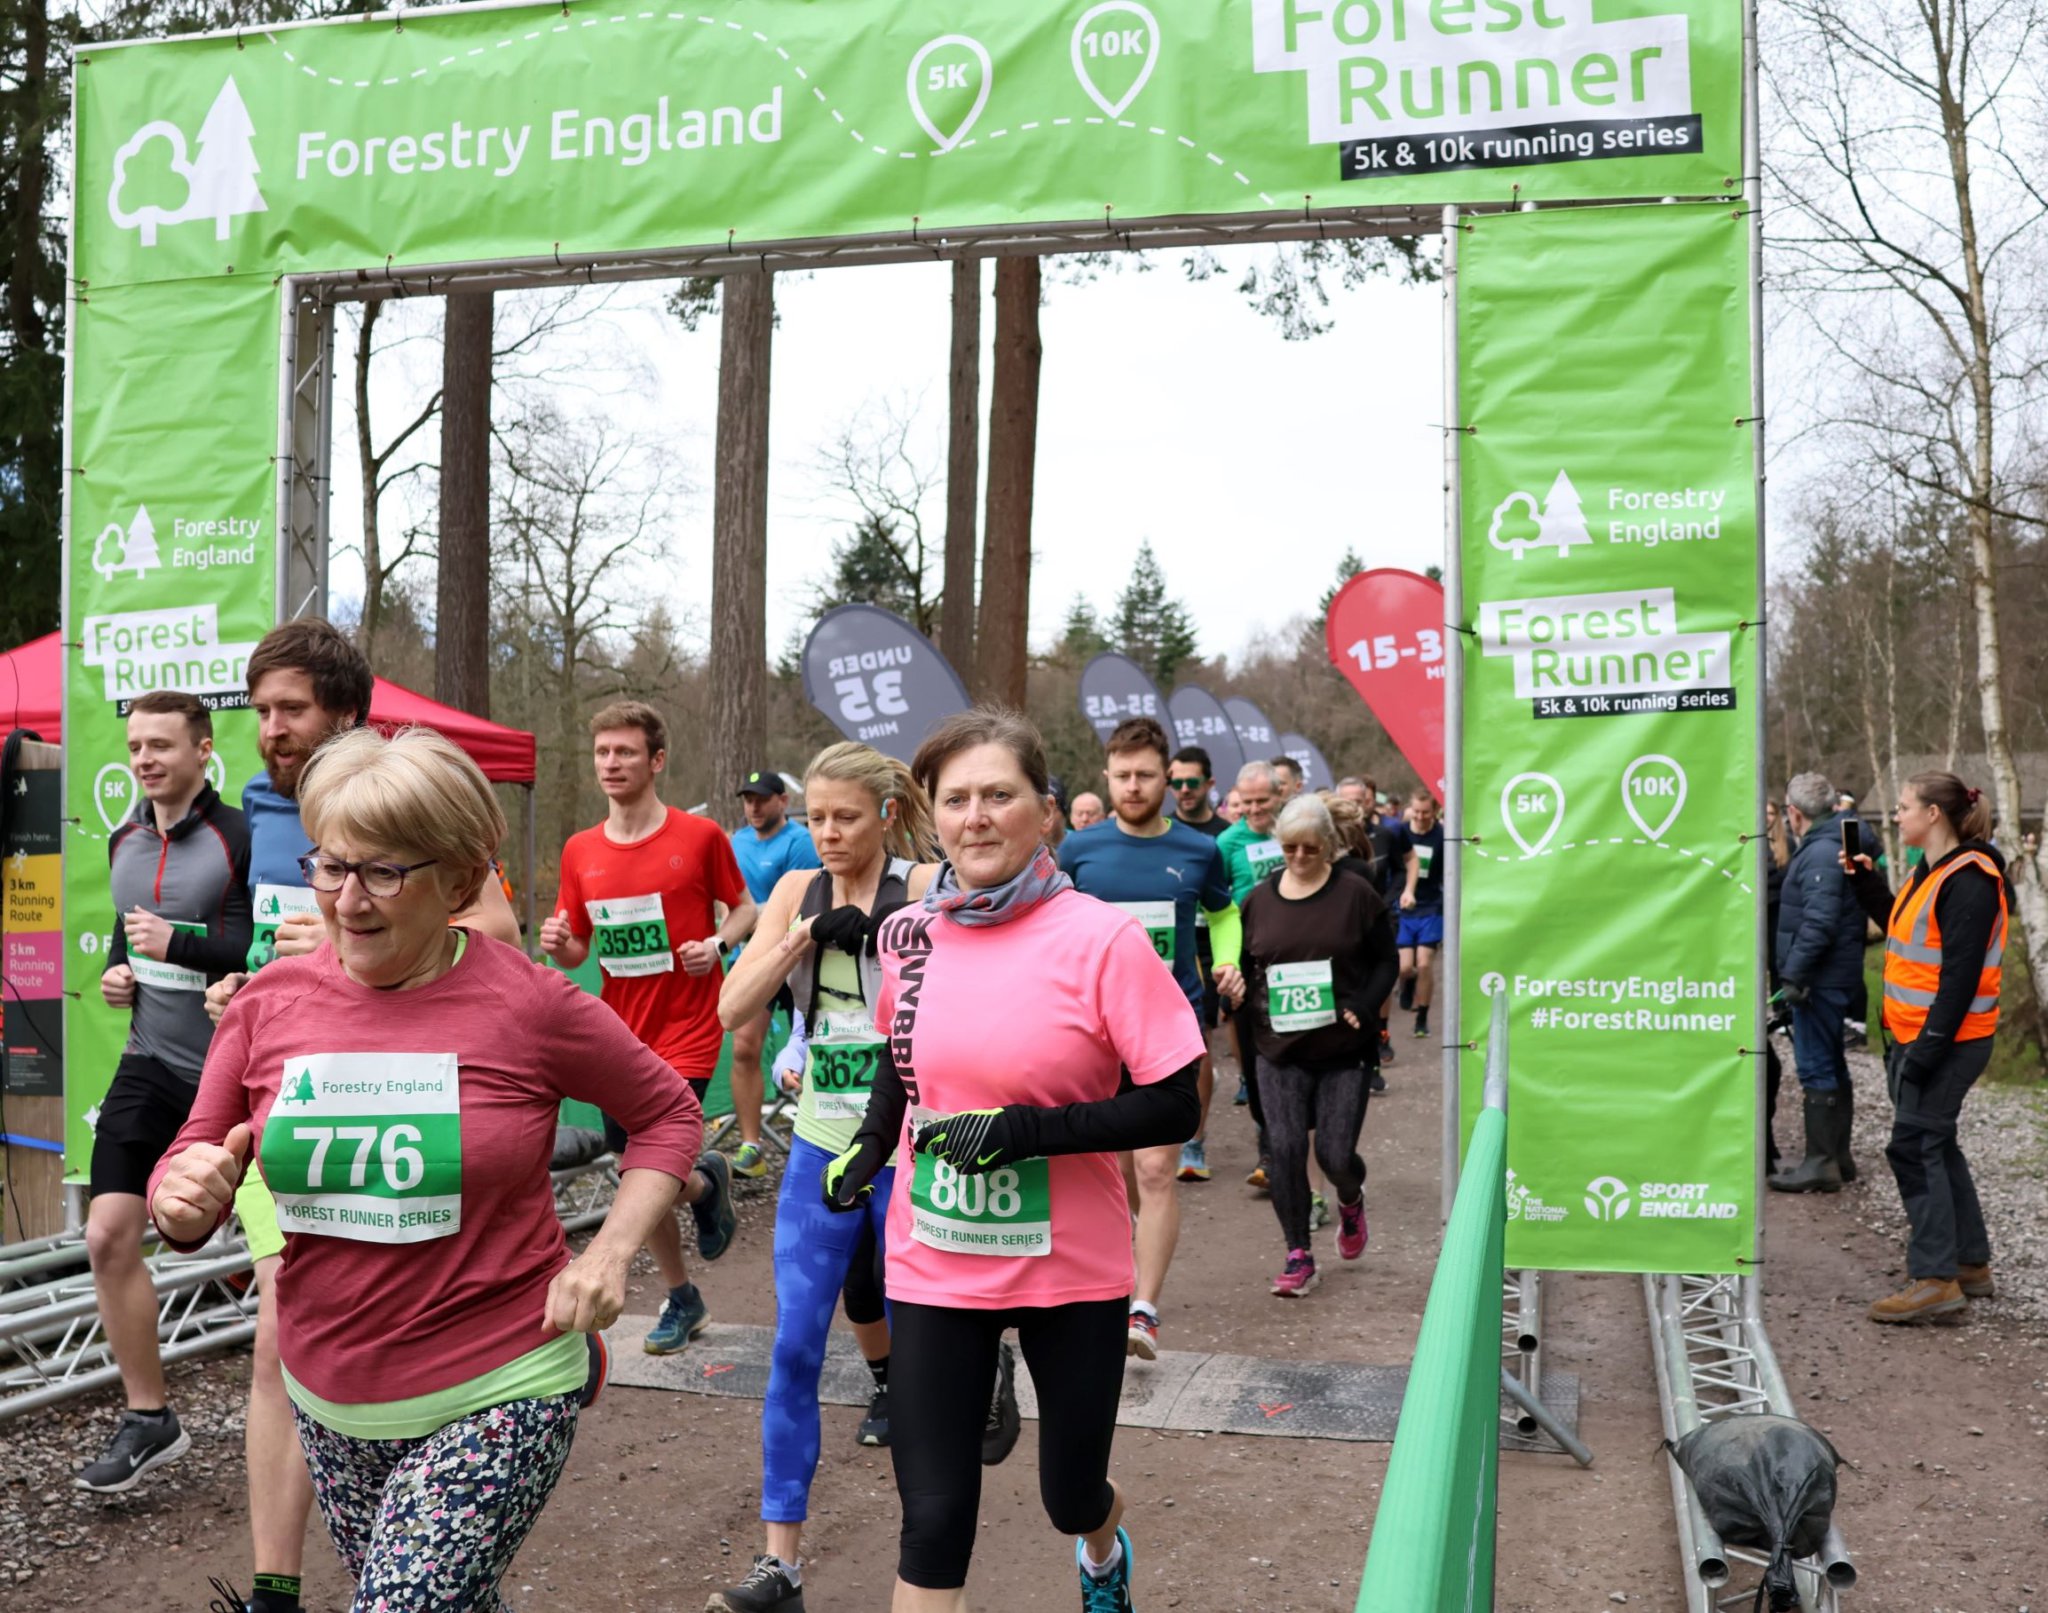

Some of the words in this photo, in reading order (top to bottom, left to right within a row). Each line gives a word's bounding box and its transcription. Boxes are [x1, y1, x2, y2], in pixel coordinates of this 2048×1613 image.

[1082, 29, 1144, 57] 10K
[927, 63, 969, 91] 5K
[1338, 47, 1662, 125] Runner
[297, 121, 530, 179] Forestry
[550, 86, 783, 166] England
[1354, 144, 1388, 170] 5k
[1394, 142, 1417, 167] &
[1424, 137, 1475, 164] 10k
[1483, 128, 1594, 159] running
[1602, 123, 1690, 149] series
[1609, 487, 1726, 511] Forestry
[174, 516, 261, 539] Forestry
[1609, 515, 1721, 547] England
[172, 543, 255, 570] England
[94, 614, 207, 655] Forest
[1498, 599, 1662, 646] Forest
[1347, 629, 1444, 672] 15-3
[115, 657, 247, 691] Runner
[1426, 665, 1444, 680] MI
[1532, 647, 1716, 688] Runner
[121, 699, 130, 715] 5
[221, 693, 249, 707] seri
[1540, 701, 1561, 715] 5k
[1564, 700, 1576, 713] &
[1581, 696, 1610, 712] 10k
[1614, 694, 1678, 711] running
[1681, 691, 1729, 707] series
[104, 782, 124, 798] 5K
[1630, 777, 1675, 796] 10K
[1517, 794, 1547, 813] 5K
[10, 879, 17, 891] 3
[18, 879, 36, 891] km
[10, 894, 55, 909] Running
[10, 909, 43, 922] Route
[600, 924, 663, 955] 3593
[881, 916, 936, 953] 10K
[10, 943, 17, 956] 5
[18, 943, 36, 956] km
[10, 959, 55, 973] Running
[149, 969, 175, 980] RUNNER
[10, 973, 43, 987] Route
[1514, 975, 1736, 1003] ForestryEngland
[1277, 986, 1322, 1012] 783
[1530, 1008, 1737, 1031] #ForestRunner
[815, 1049, 882, 1089] 362
[322, 1080, 382, 1095] Forestry
[387, 1079, 443, 1094] England
[293, 1124, 425, 1191] 776
[930, 1159, 1021, 1217] 808
[1639, 1182, 1709, 1199] SPORT
[1525, 1198, 1543, 1206] THE
[1525, 1206, 1569, 1215] NATIONAL
[1639, 1202, 1739, 1219] ENGLAND
[285, 1205, 335, 1222] FOREST
[340, 1209, 394, 1228] RUNNER
[398, 1209, 451, 1228] SERIES
[1525, 1213, 1566, 1222] LOTTERY
[917, 1219, 948, 1239] FOREST
[951, 1230, 998, 1244] RUNNER
[1001, 1233, 1043, 1246] SERIES
